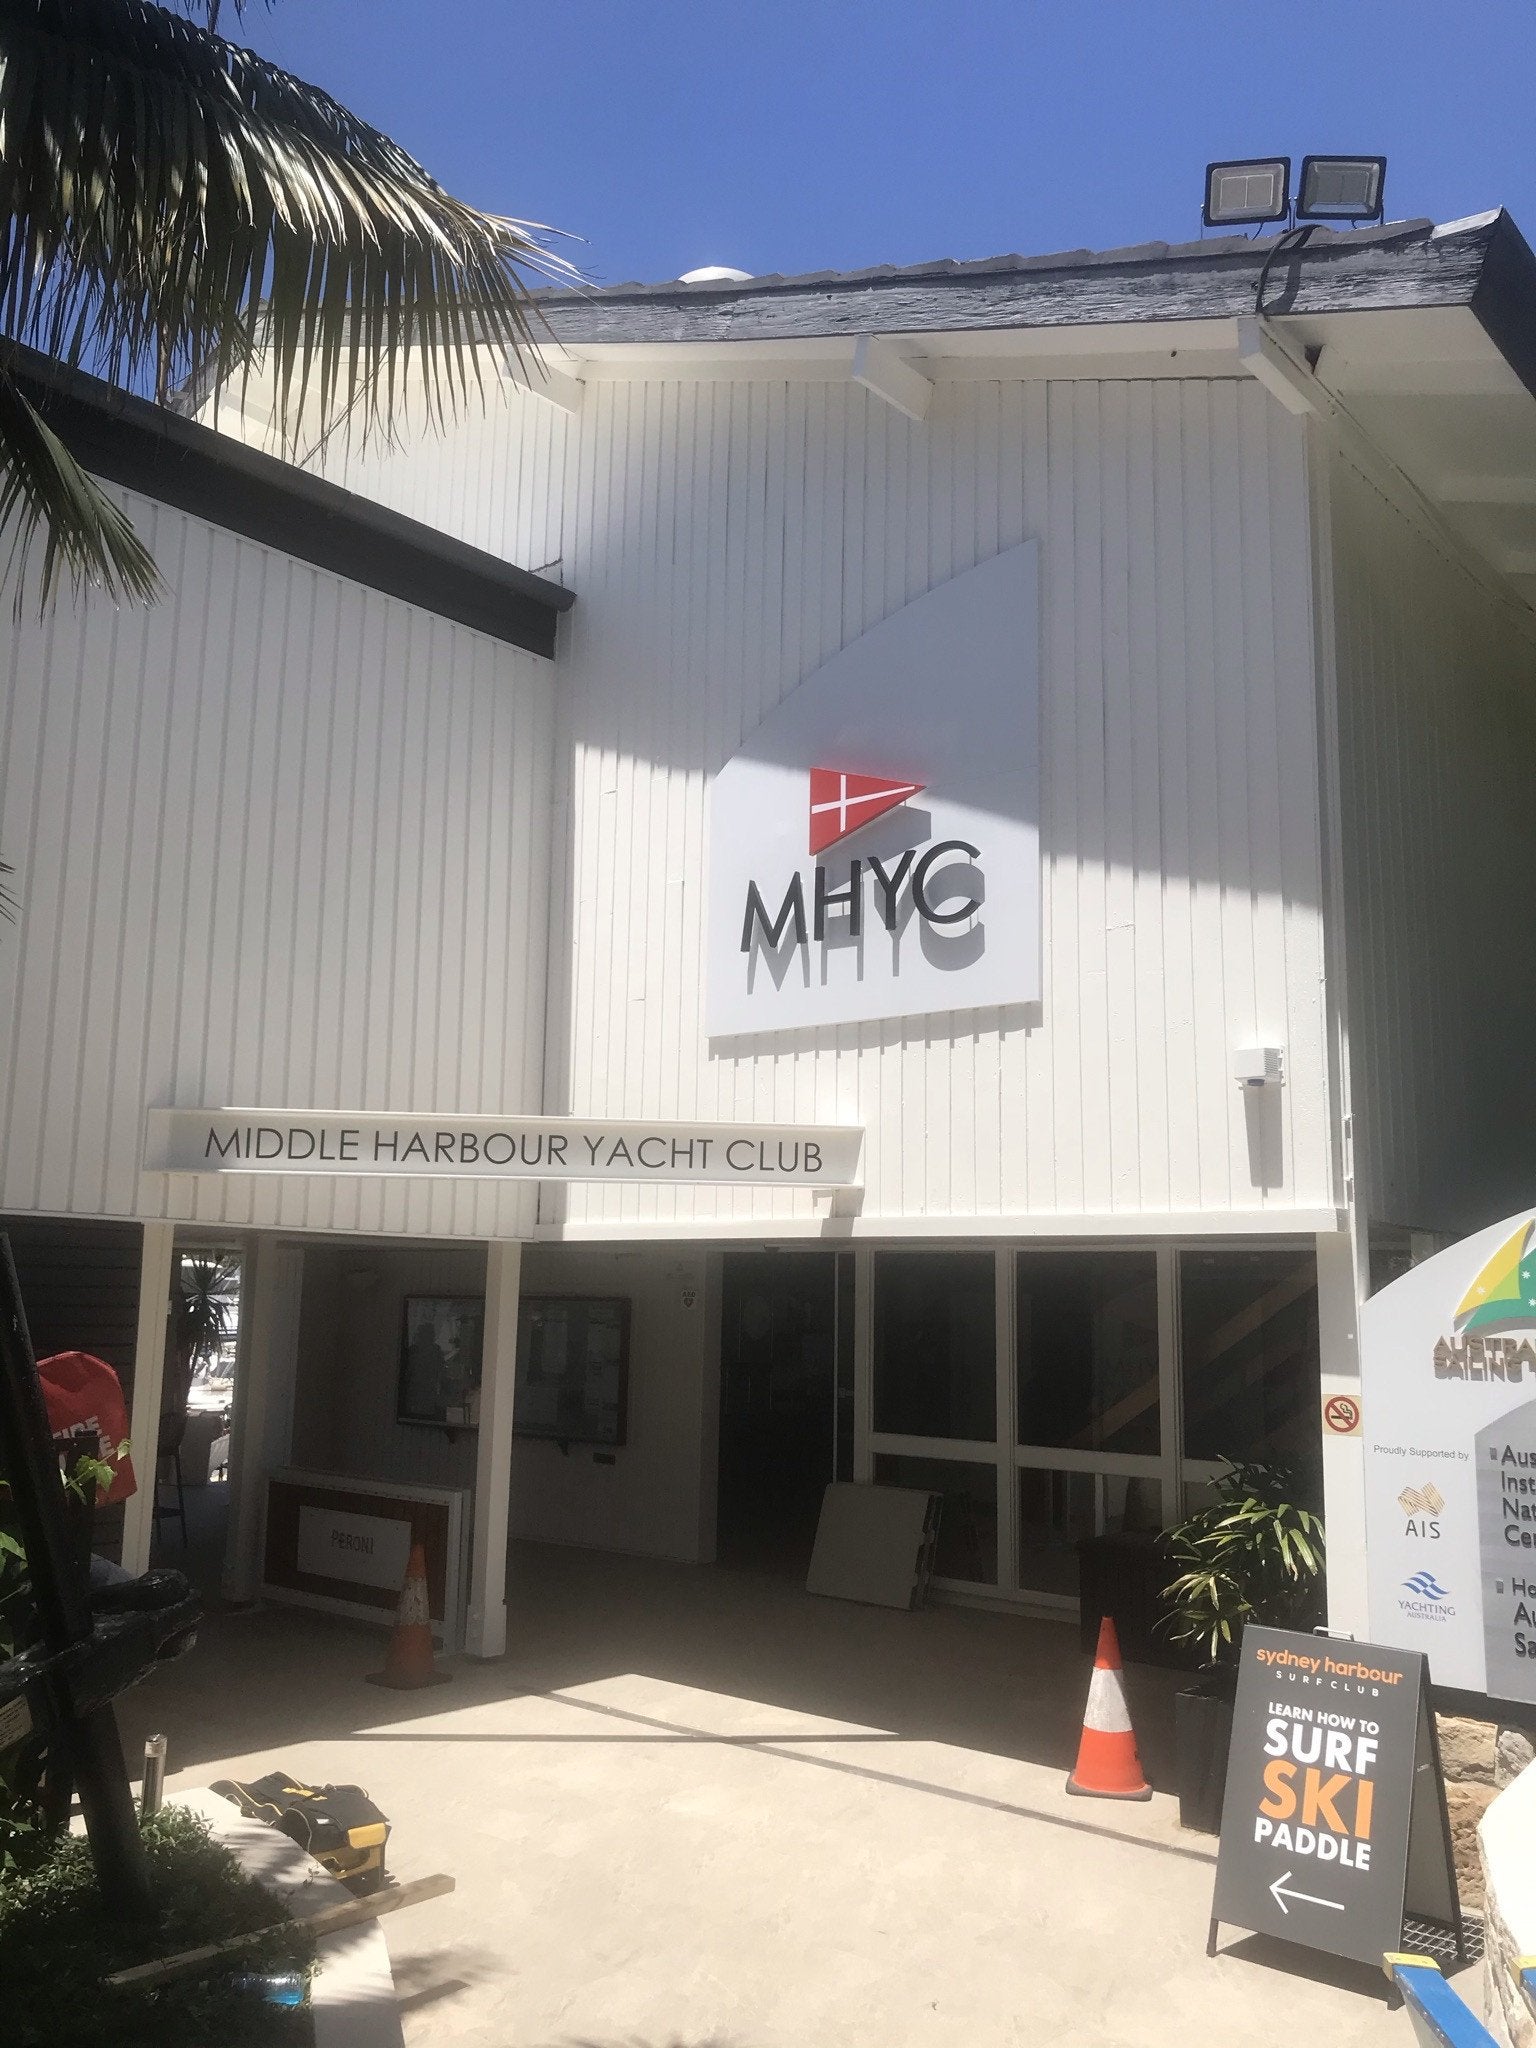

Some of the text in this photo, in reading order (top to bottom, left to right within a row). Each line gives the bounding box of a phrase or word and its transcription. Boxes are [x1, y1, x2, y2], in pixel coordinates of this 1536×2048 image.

[740, 840, 982, 952] MHYC
[204, 1126, 823, 1172] MIDDLE HARBOUR YACHT CLUB
[1433, 1335, 1536, 1356] AUSTRA
[1373, 1445, 1469, 1461] Proudly Supported by
[330, 1528, 374, 1554] PERONI
[1405, 1519, 1441, 1539] AIS
[1398, 1600, 1456, 1616] YACHTING
[1407, 1611, 1447, 1622] AUSTRALIA
[1256, 1648, 1404, 1685] sydney harbour
[1268, 1702, 1380, 1735] LEARN HOW TO
[1263, 1718, 1379, 1775] SURF
[1258, 1759, 1374, 1840] SKI
[1254, 1816, 1371, 1871] PADDLE
